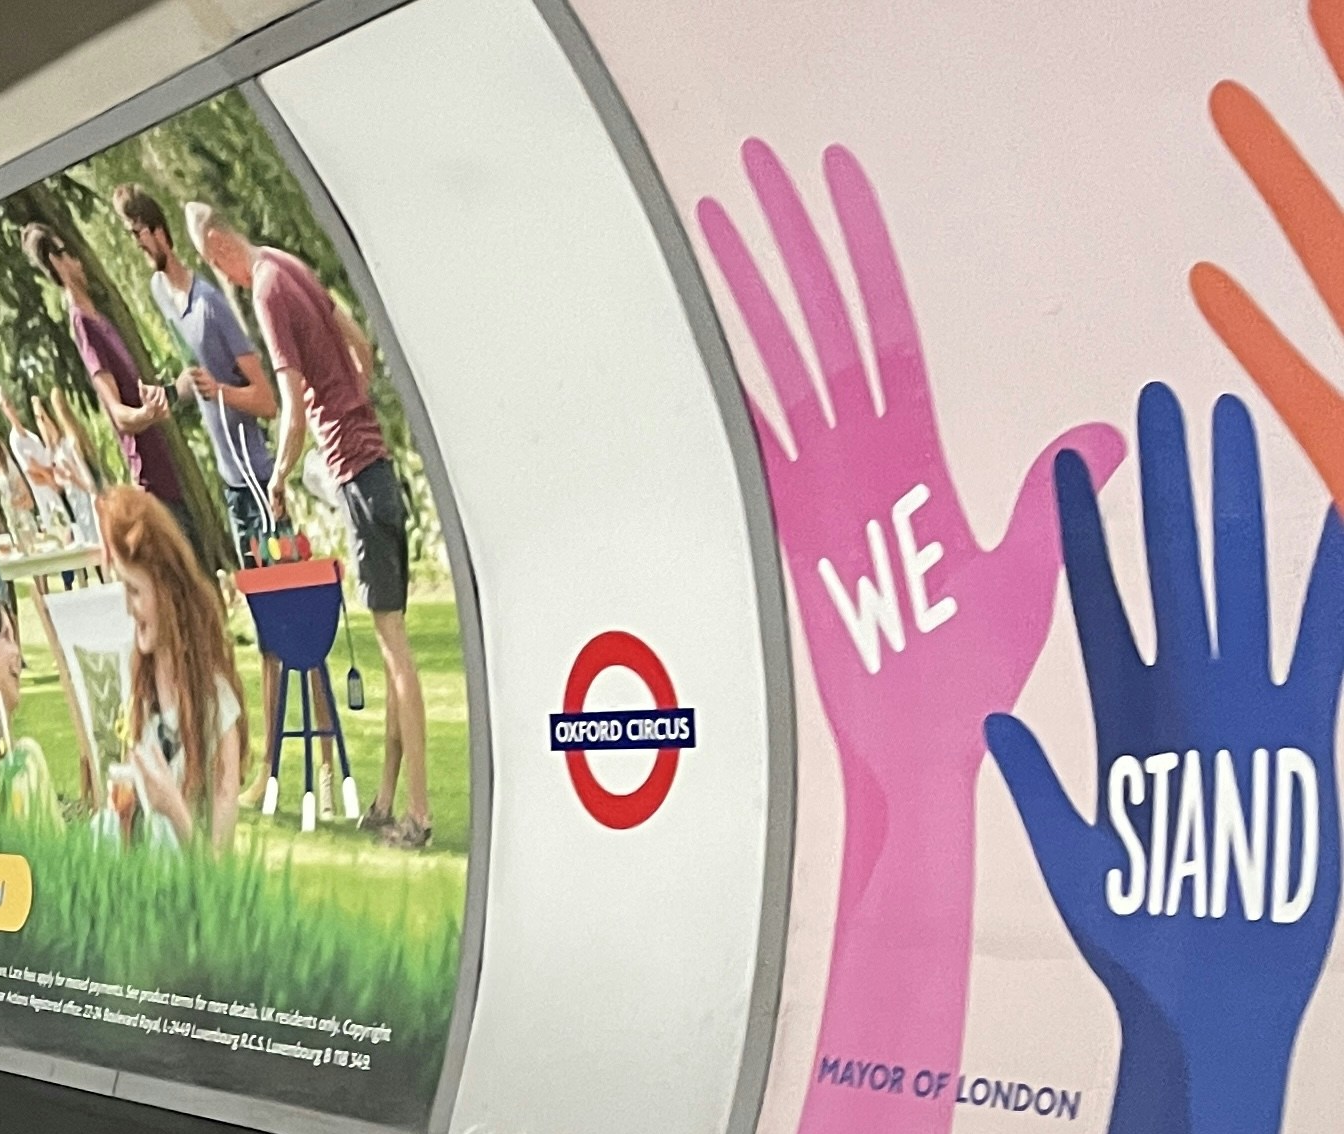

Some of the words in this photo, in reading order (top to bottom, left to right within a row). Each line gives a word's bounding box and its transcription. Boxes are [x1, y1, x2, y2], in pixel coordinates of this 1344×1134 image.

[817, 483, 958, 675] WE
[555, 719, 623, 743] OXFORD
[626, 717, 690, 741] CIRCUS
[1106, 746, 1321, 924] STAND
[342, 1018, 393, 1044] Copyright
[817, 1054, 906, 1095] MAYOR
[914, 1069, 951, 1100] OF
[954, 1074, 1082, 1121] LONDON
